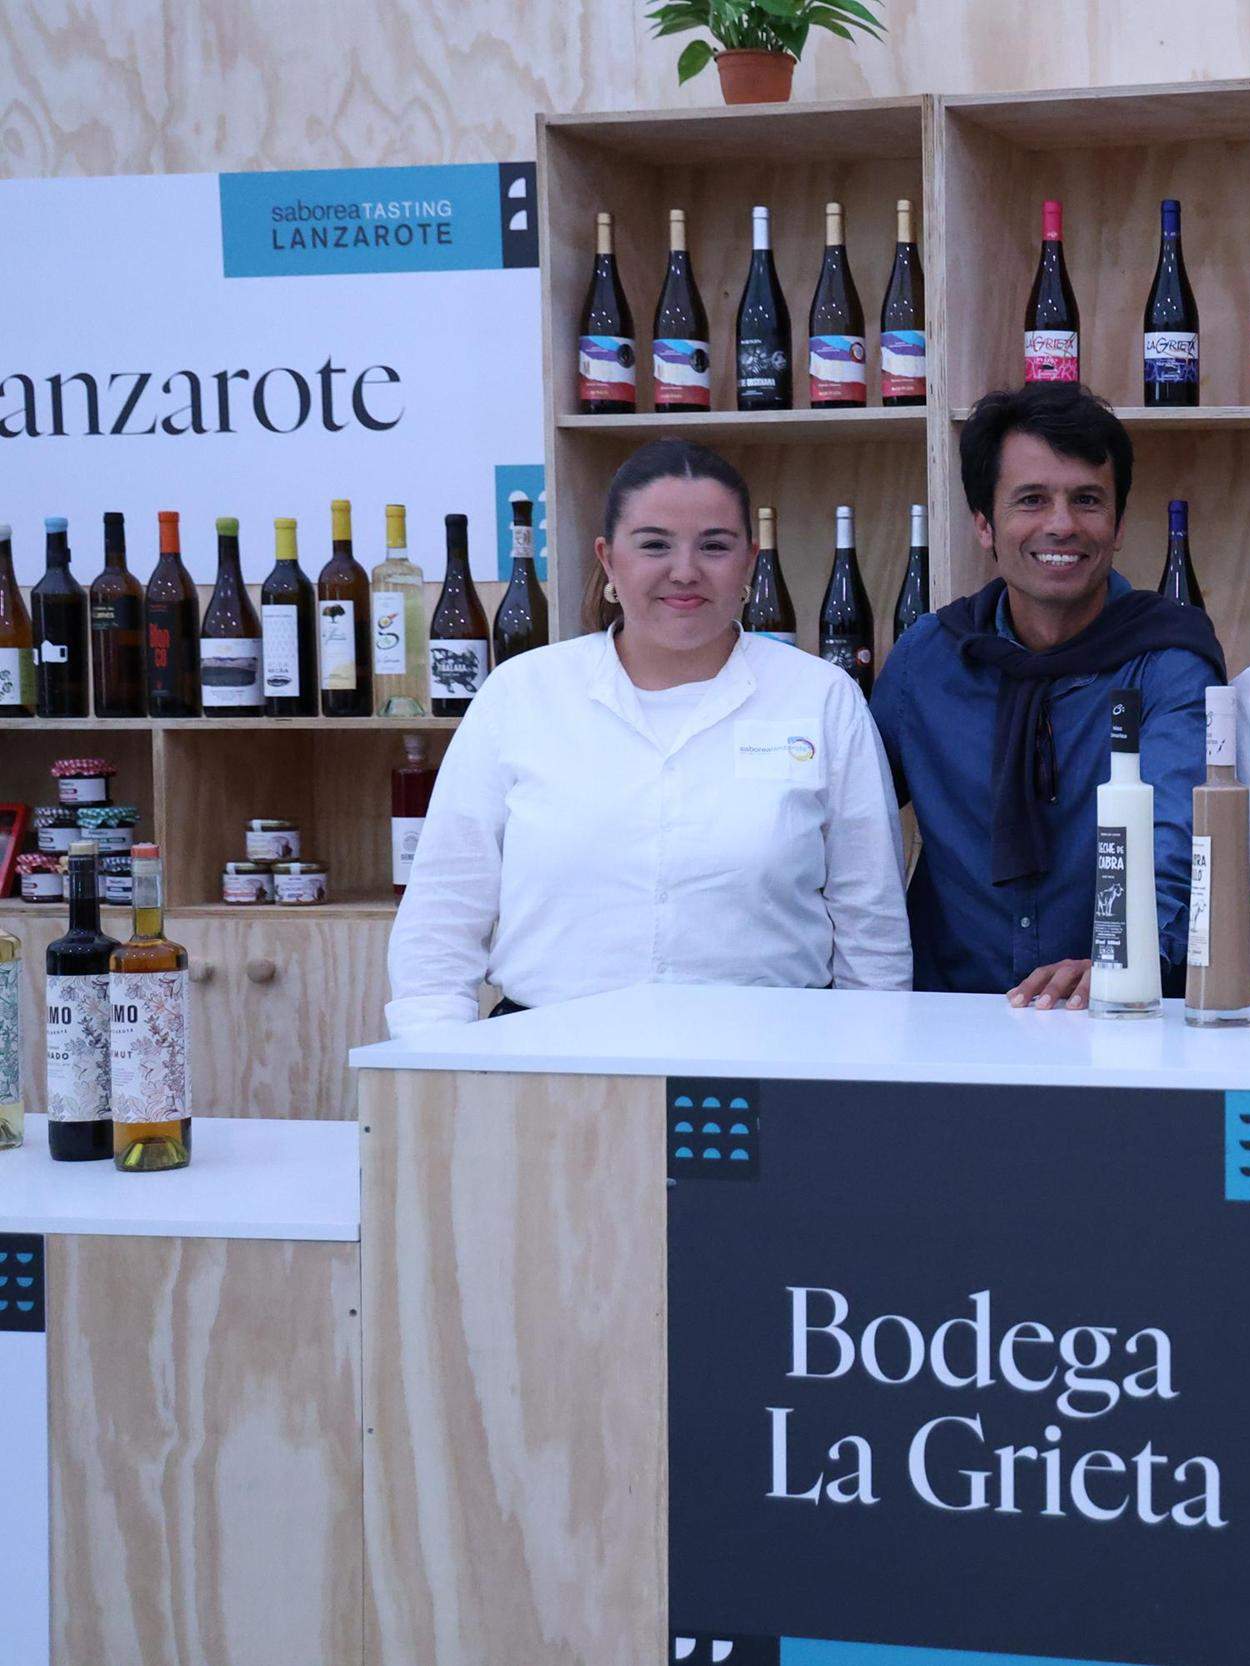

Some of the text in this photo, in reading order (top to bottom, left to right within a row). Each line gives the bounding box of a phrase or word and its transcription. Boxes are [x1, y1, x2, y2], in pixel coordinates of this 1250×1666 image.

[272, 222, 454, 250] LANZAROTE
[0, 355, 405, 438] anzarote
[47, 1006, 72, 1025] MO
[785, 1286, 1180, 1418] Bodega
[765, 1407, 1229, 1529] La Grieta
